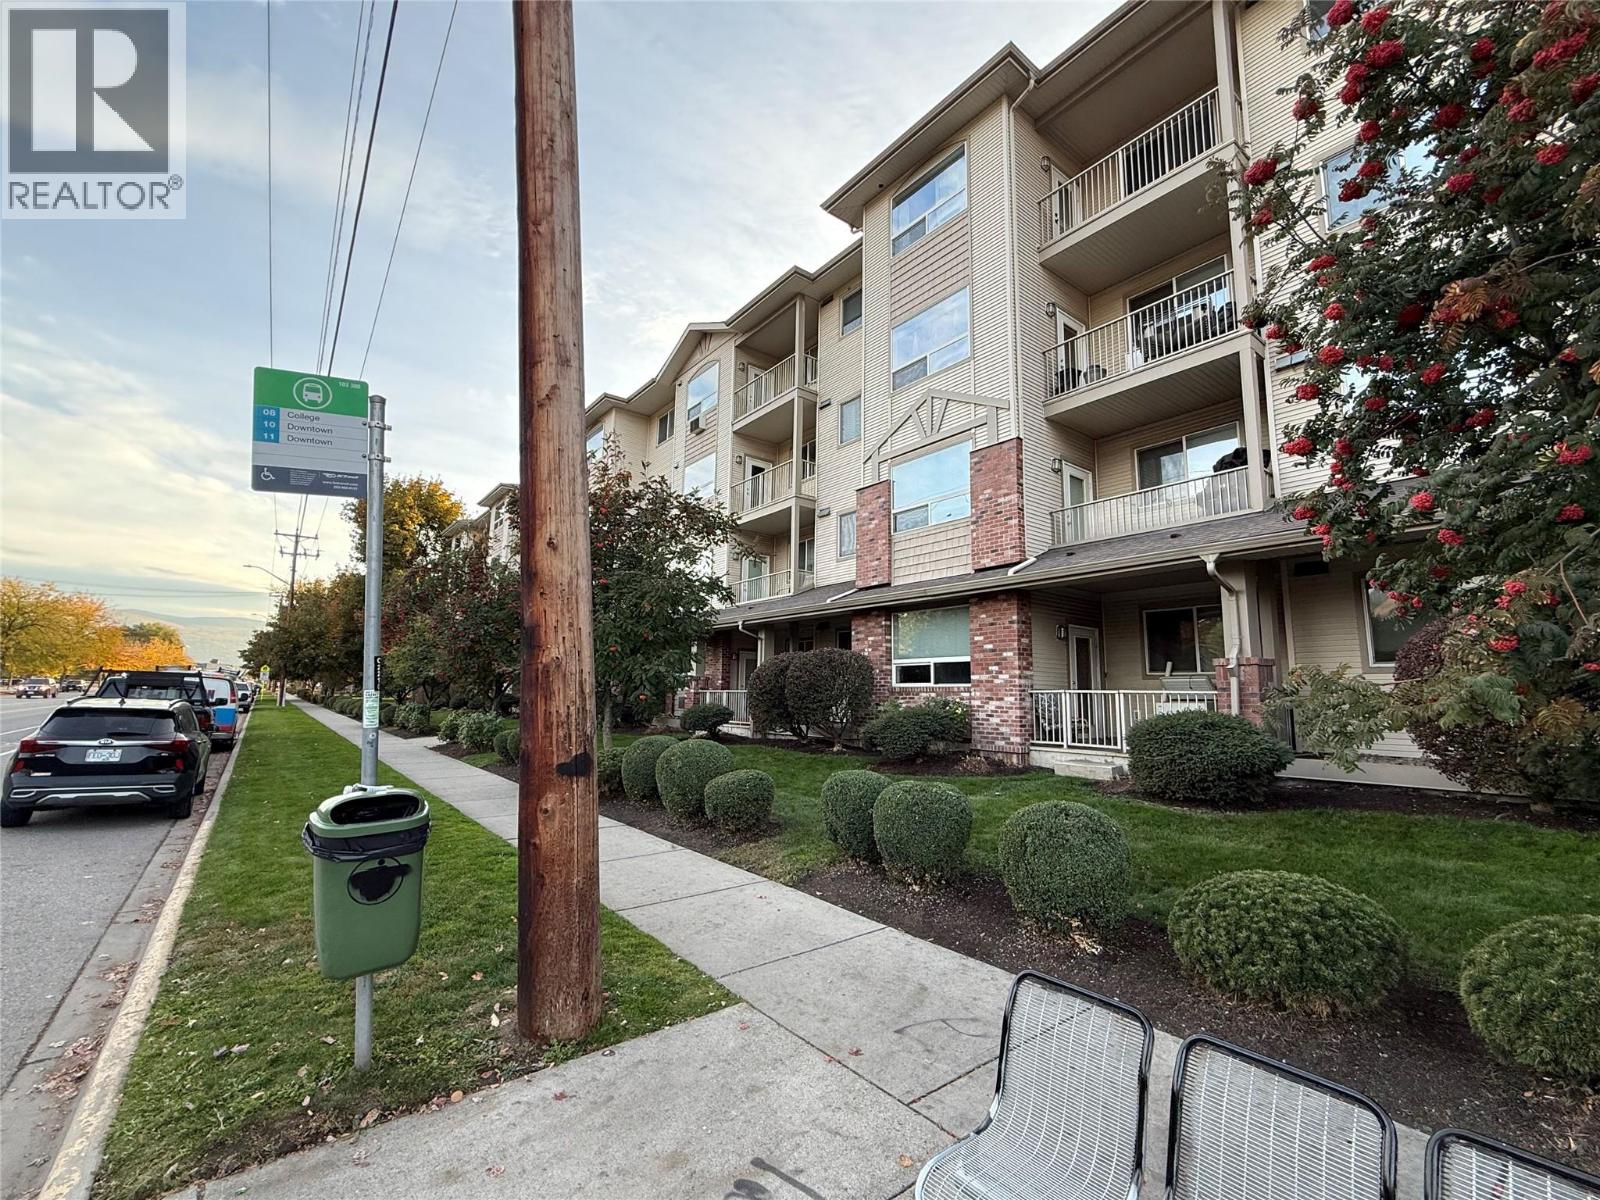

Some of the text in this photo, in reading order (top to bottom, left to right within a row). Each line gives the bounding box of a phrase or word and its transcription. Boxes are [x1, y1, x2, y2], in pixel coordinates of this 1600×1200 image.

[263, 408, 320, 422] 08 College
[287, 422, 333, 434] Downtown
[287, 434, 333, 446] Downtown
